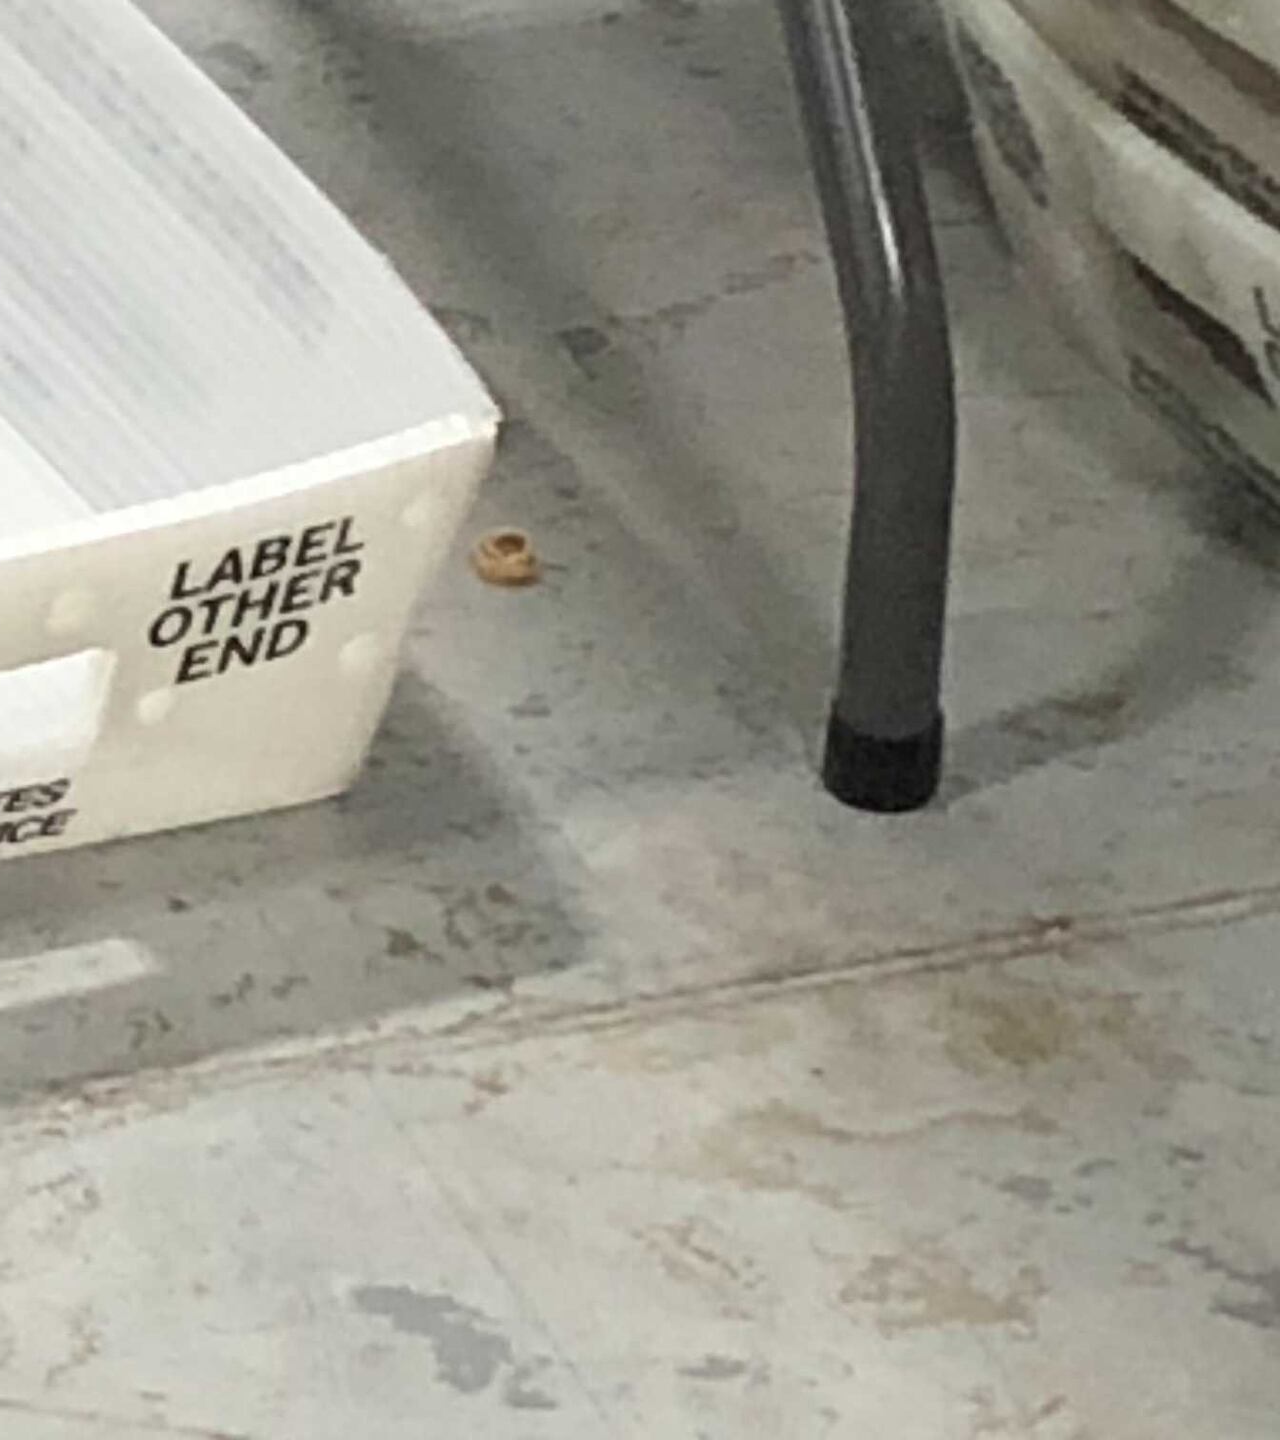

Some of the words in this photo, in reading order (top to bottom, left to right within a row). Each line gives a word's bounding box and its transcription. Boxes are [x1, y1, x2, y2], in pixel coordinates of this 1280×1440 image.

[170, 516, 365, 600] LABEL
[147, 558, 362, 648] OTHER
[174, 618, 309, 685] END
